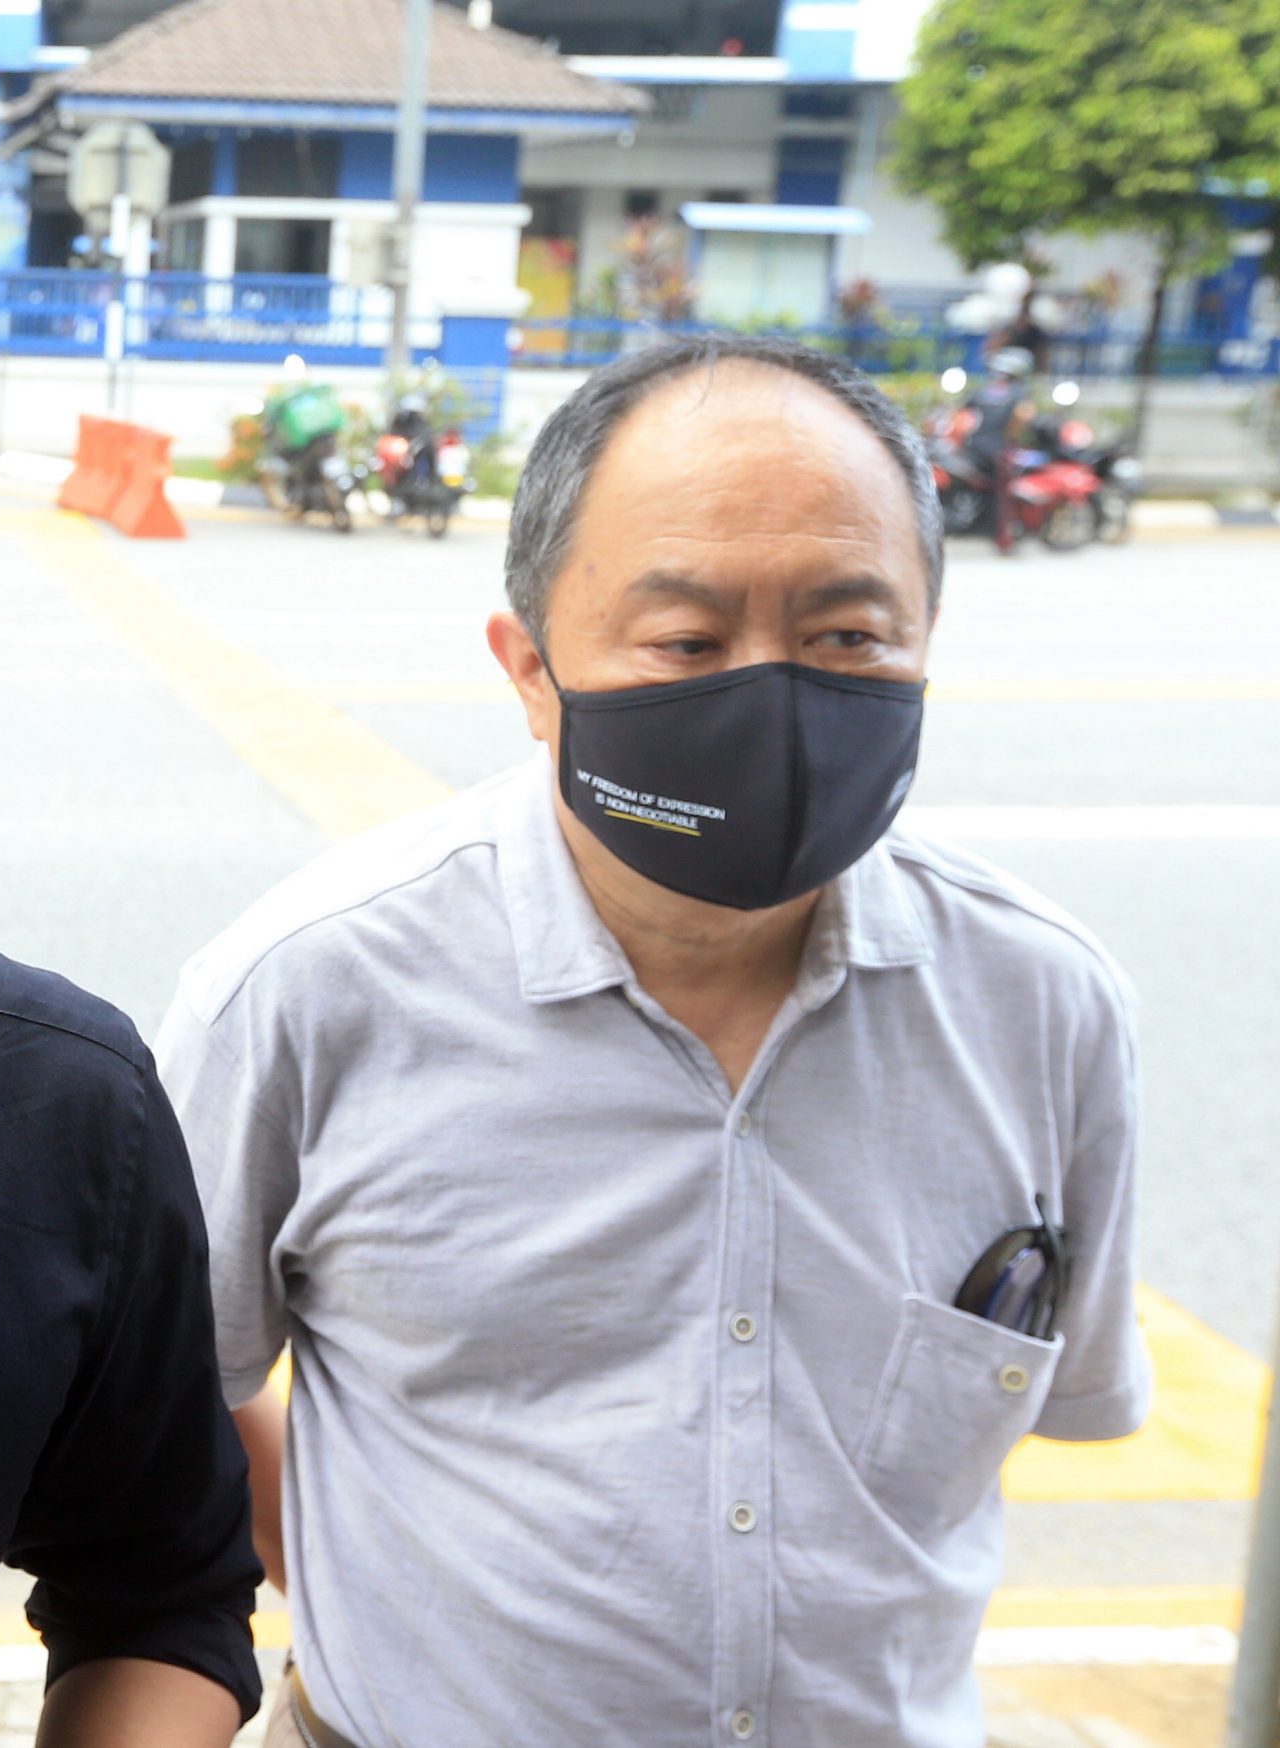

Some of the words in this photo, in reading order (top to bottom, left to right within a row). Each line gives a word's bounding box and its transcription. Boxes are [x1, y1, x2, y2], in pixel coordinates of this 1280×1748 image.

[591, 775, 637, 802] FREEDOM
[638, 792, 655, 805] OF
[657, 796, 725, 820] EXPRESSION
[595, 792, 605, 805] IS
[606, 797, 698, 829] NON-NEGOTIABLE
